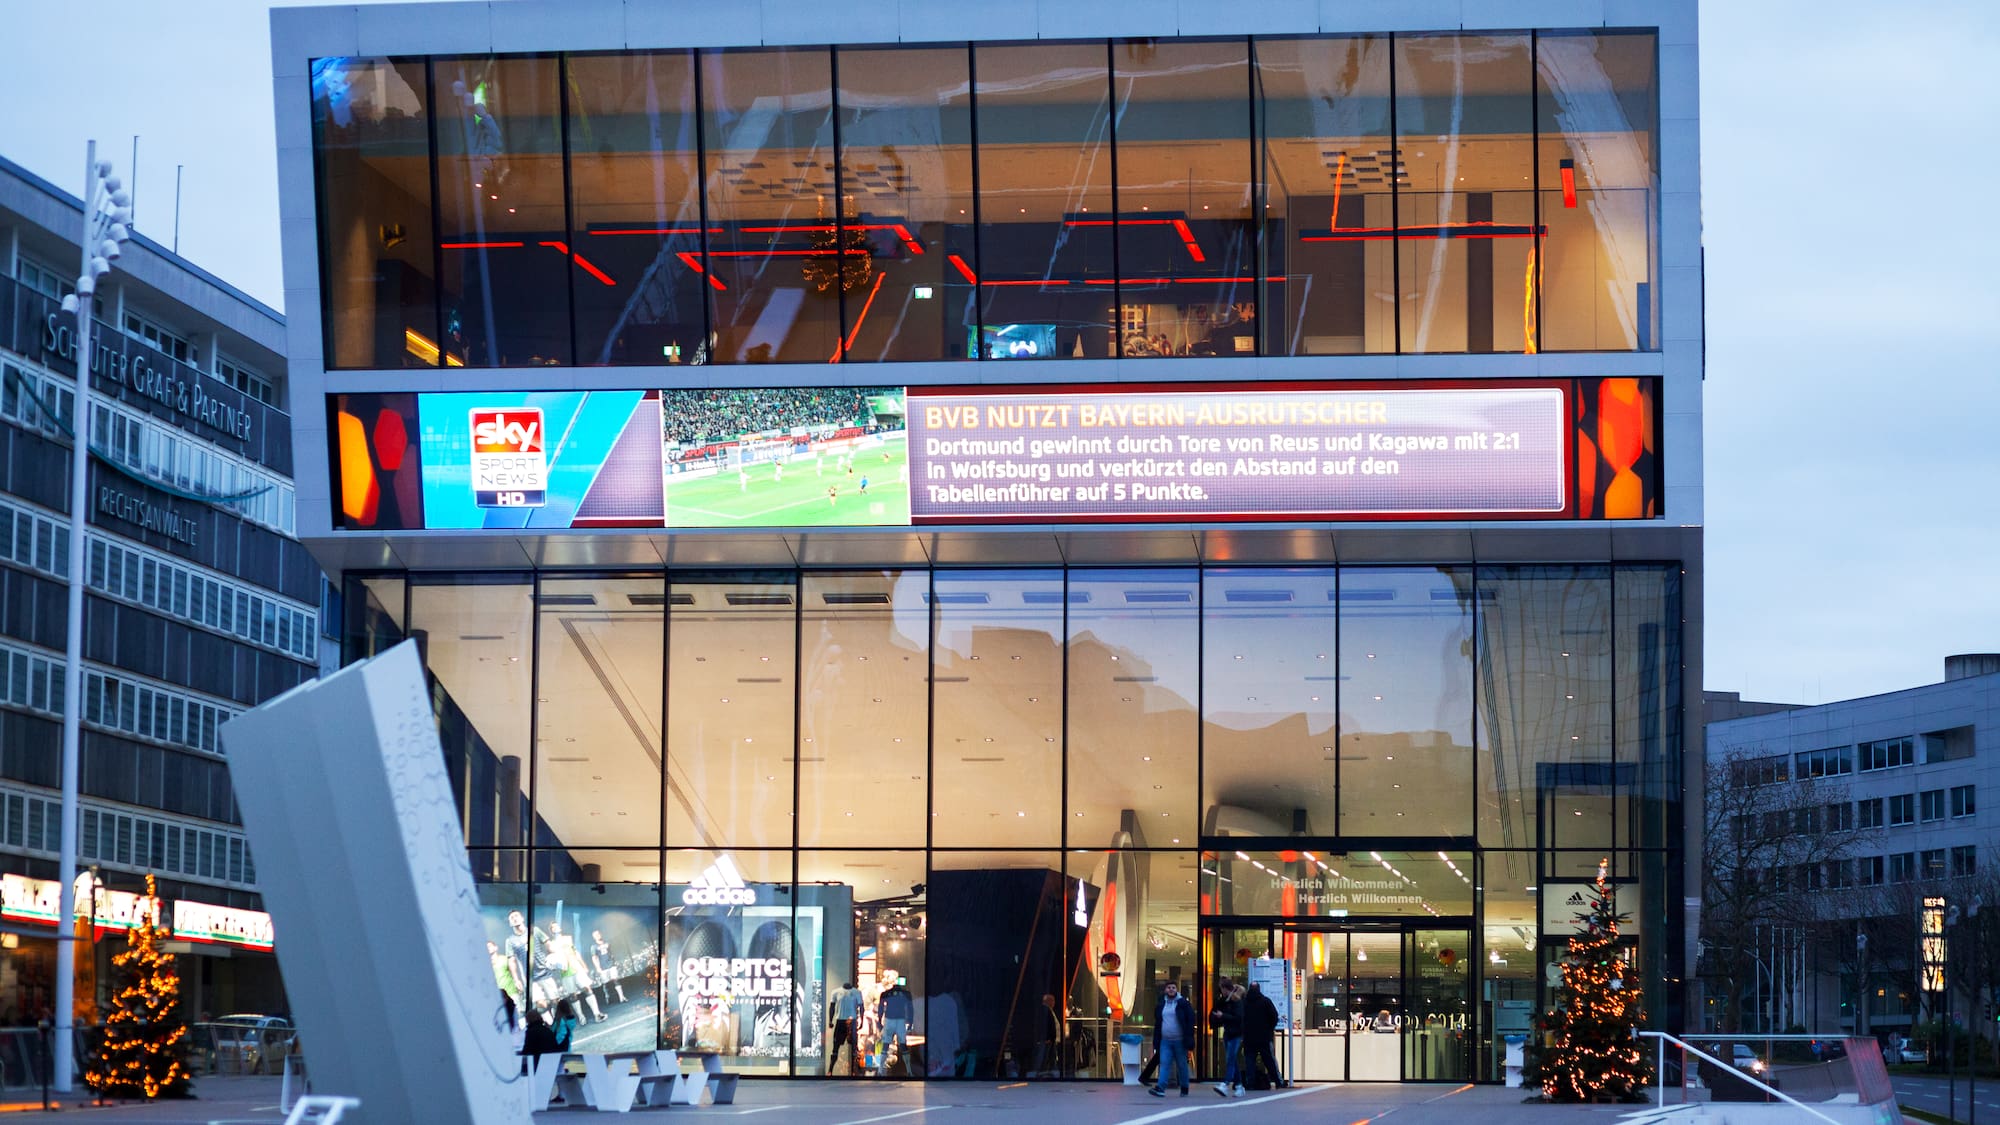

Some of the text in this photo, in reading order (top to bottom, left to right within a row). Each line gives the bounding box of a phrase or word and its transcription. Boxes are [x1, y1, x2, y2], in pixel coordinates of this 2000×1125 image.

[47, 313, 251, 442] SCHÜTER GRAF & PARTNER
[925, 401, 1388, 429] BVB NUTZT BAYERN-AUSRUTSCHER
[476, 413, 538, 452] sky
[926, 432, 1520, 458] Dortmund gewinnt durch Tore von Reus und Kagawa mit 2:1
[479, 458, 539, 471] SPORT
[952, 460, 1050, 482] Wolfsburg
[1057, 460, 1094, 478] und
[1100, 459, 1183, 477] verkürzt
[1190, 458, 1227, 476] den
[1233, 457, 1316, 476] Abstand
[1322, 457, 1356, 475] auf
[1361, 457, 1399, 475] den
[480, 473, 538, 485] NEWS
[497, 491, 525, 505] HD
[927, 482, 1209, 503] Tabellenführer auf 5 Punkte.
[100, 486, 197, 547] RECHTSANWÄLTE
[1271, 878, 1403, 889] Herzlich Willkommen
[682, 887, 756, 905] adidas
[1298, 894, 1422, 904] Herzlich Willkommen
[682, 958, 729, 977] OUR
[682, 978, 728, 997] OUR
